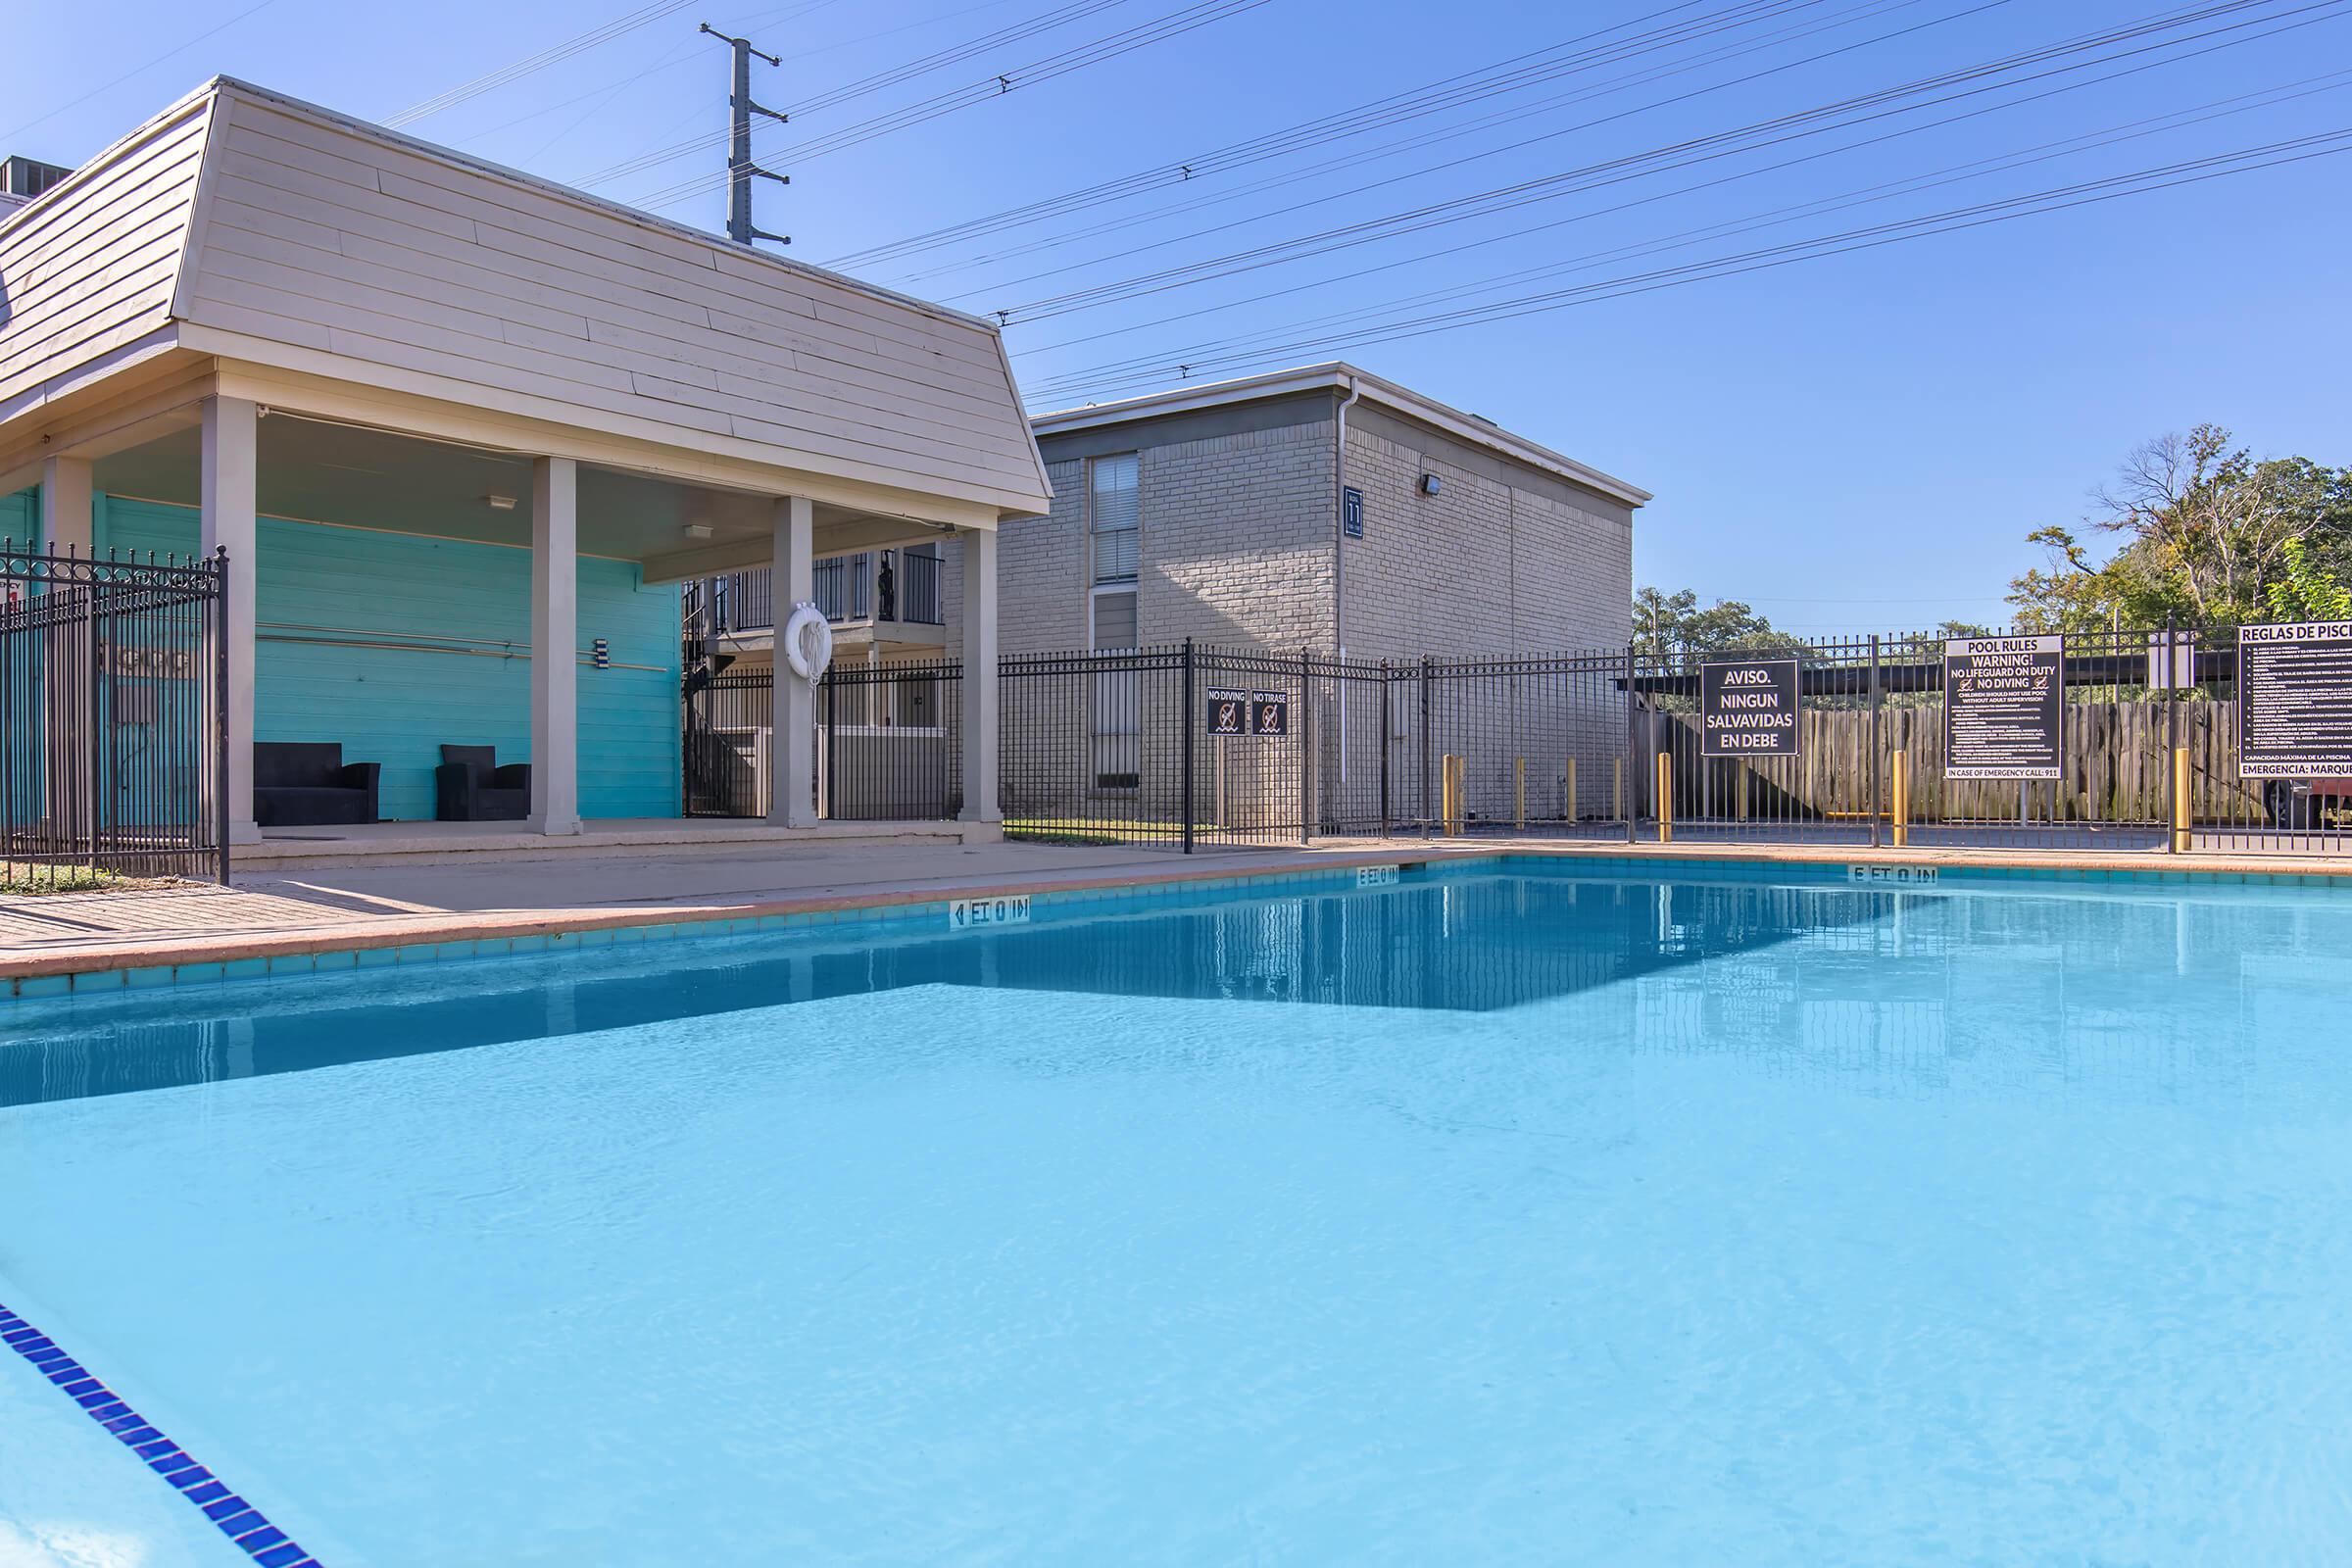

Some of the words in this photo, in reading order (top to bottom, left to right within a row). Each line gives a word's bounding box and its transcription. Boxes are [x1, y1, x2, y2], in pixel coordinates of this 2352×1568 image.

[1348, 503, 1360, 523] 11
[2242, 627, 2293, 641] REGLAS
[2297, 625, 2317, 639] DE
[1968, 641, 1999, 654] POOL
[2002, 639, 2038, 652] RULES
[1972, 654, 2034, 667] WARNING!
[1725, 670, 1772, 684] AVISO.
[1951, 668, 1966, 678] NO
[1966, 667, 2014, 678] LIFEGUARD
[2015, 666, 2029, 676] ON
[2031, 666, 2056, 675] DUTY
[1977, 678, 1993, 689] NO
[1993, 678, 2030, 688] DIVING
[1208, 690, 1219, 700] NO
[1221, 692, 1245, 702] DIVING
[1253, 693, 1264, 703] NO
[1264, 693, 1286, 704] TIRASE
[1721, 693, 1778, 709] NINGUN
[1707, 713, 1793, 729] SALVAVIDAS
[1721, 733, 1740, 749] EN
[1742, 733, 1779, 748] DEBE
[2242, 764, 2309, 774] EMERGENCIA:
